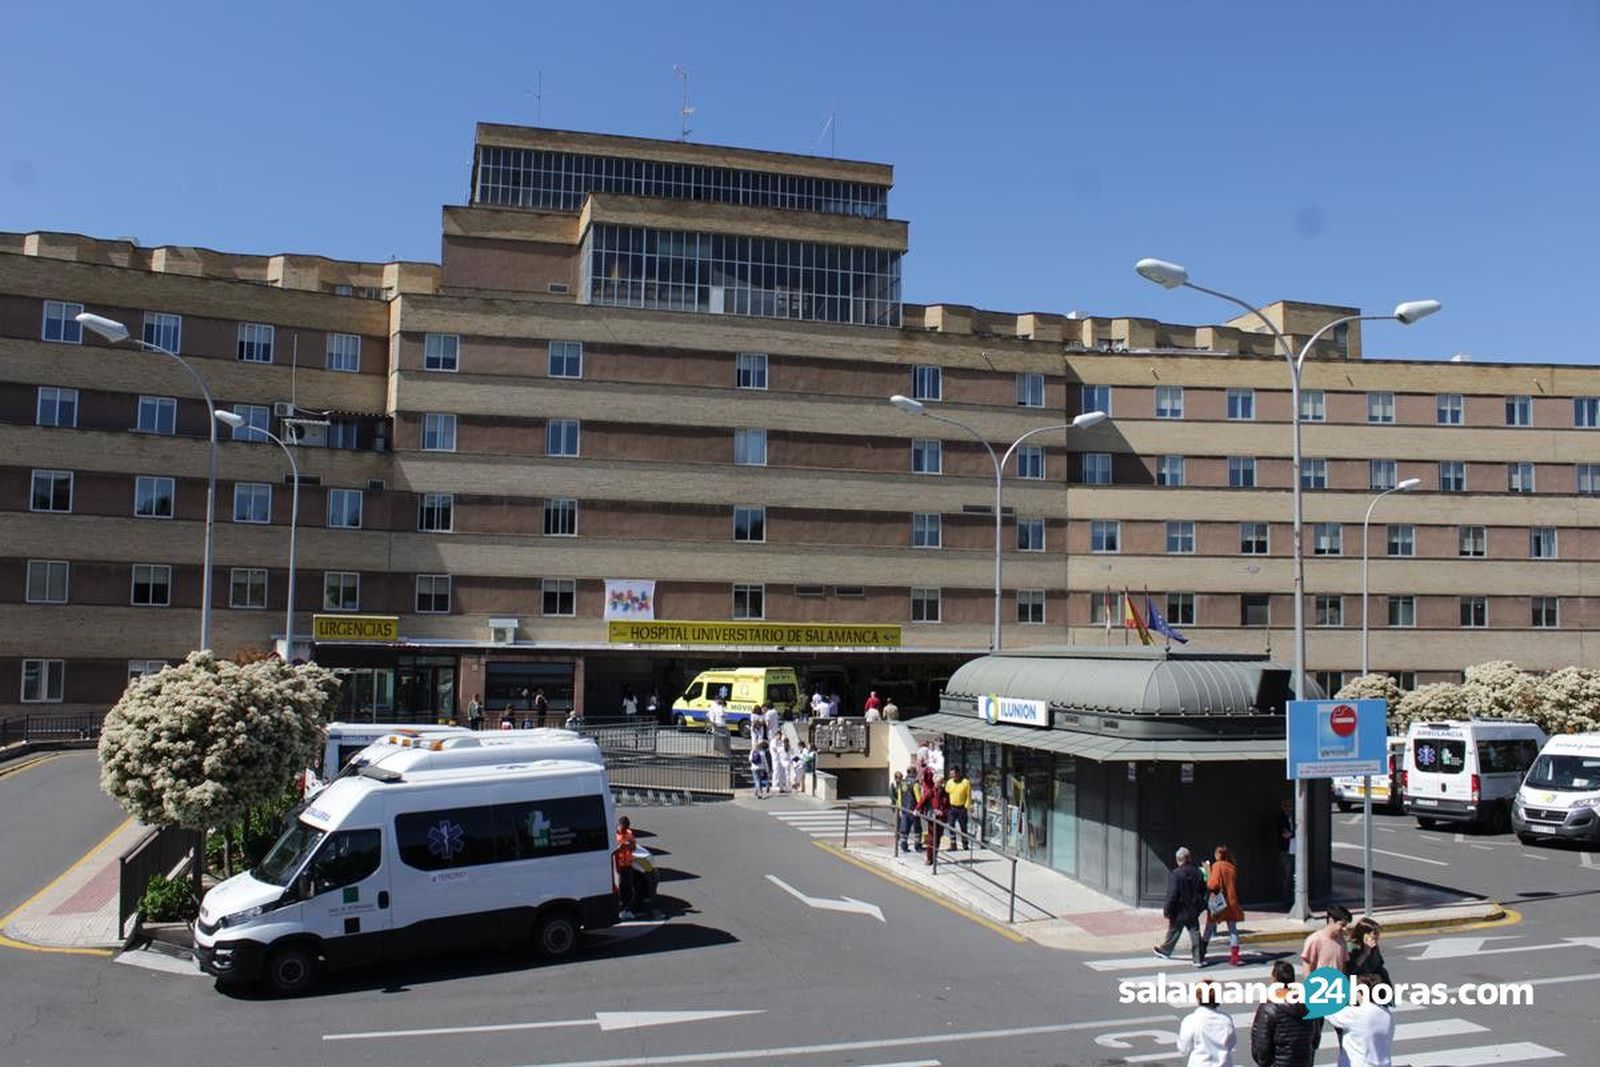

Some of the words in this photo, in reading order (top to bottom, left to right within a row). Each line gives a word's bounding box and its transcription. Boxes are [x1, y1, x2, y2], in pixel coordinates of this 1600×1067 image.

[319, 621, 393, 637] URGENCIAS
[630, 625, 689, 641] HOSPITAL
[692, 626, 784, 643] UNIVERSITARIO
[787, 628, 802, 643] DE
[804, 629, 879, 644] SALAMANCA
[1000, 701, 1037, 720] ILUNION
